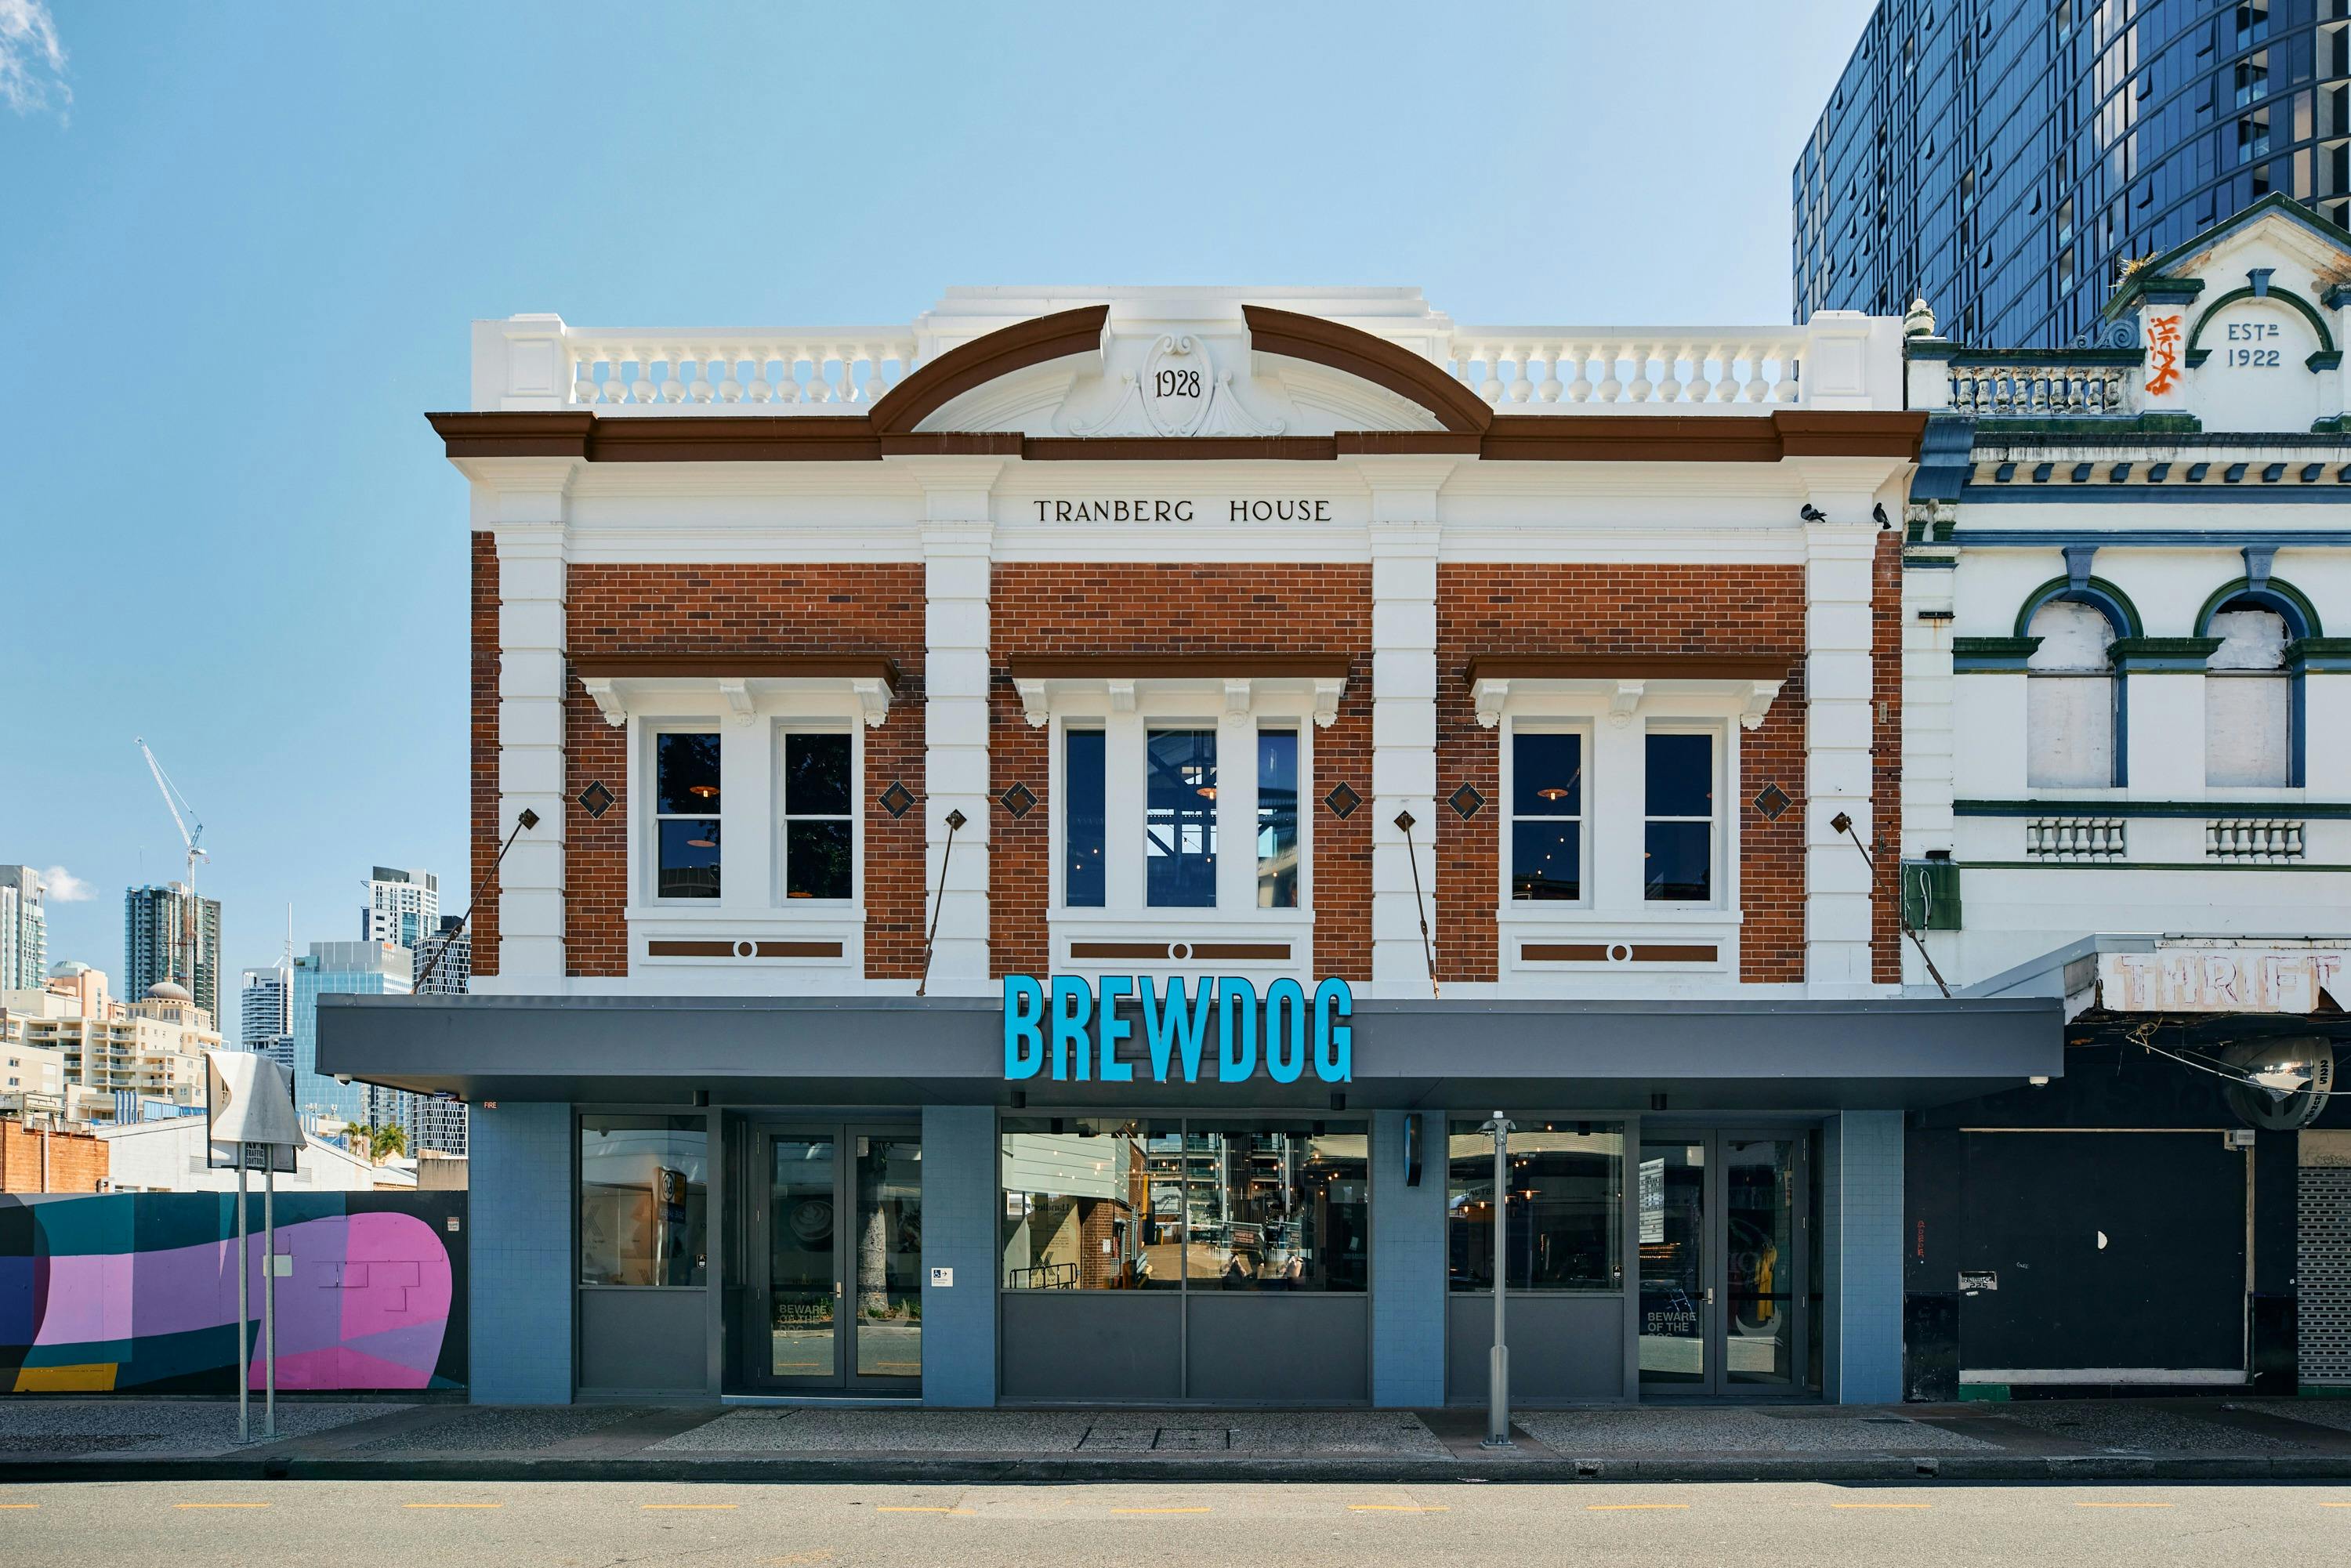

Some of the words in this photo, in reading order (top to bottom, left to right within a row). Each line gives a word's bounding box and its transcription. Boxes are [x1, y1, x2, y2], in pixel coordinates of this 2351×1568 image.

[2228, 349, 2280, 368] 1922
[1154, 370, 1201, 398] 1928
[1033, 500, 1194, 522] TRANBERG
[1229, 500, 1332, 522] HOUSE
[2114, 954, 2342, 1011] THRIFT
[1003, 975, 1353, 1084] BREWDOG
[2319, 1059, 2329, 1085] 225
[779, 1305, 827, 1314] BEWARE
[1647, 1312, 1697, 1321] BEWARE
[1647, 1322, 1664, 1331] OF
[1665, 1322, 1689, 1331] THE
